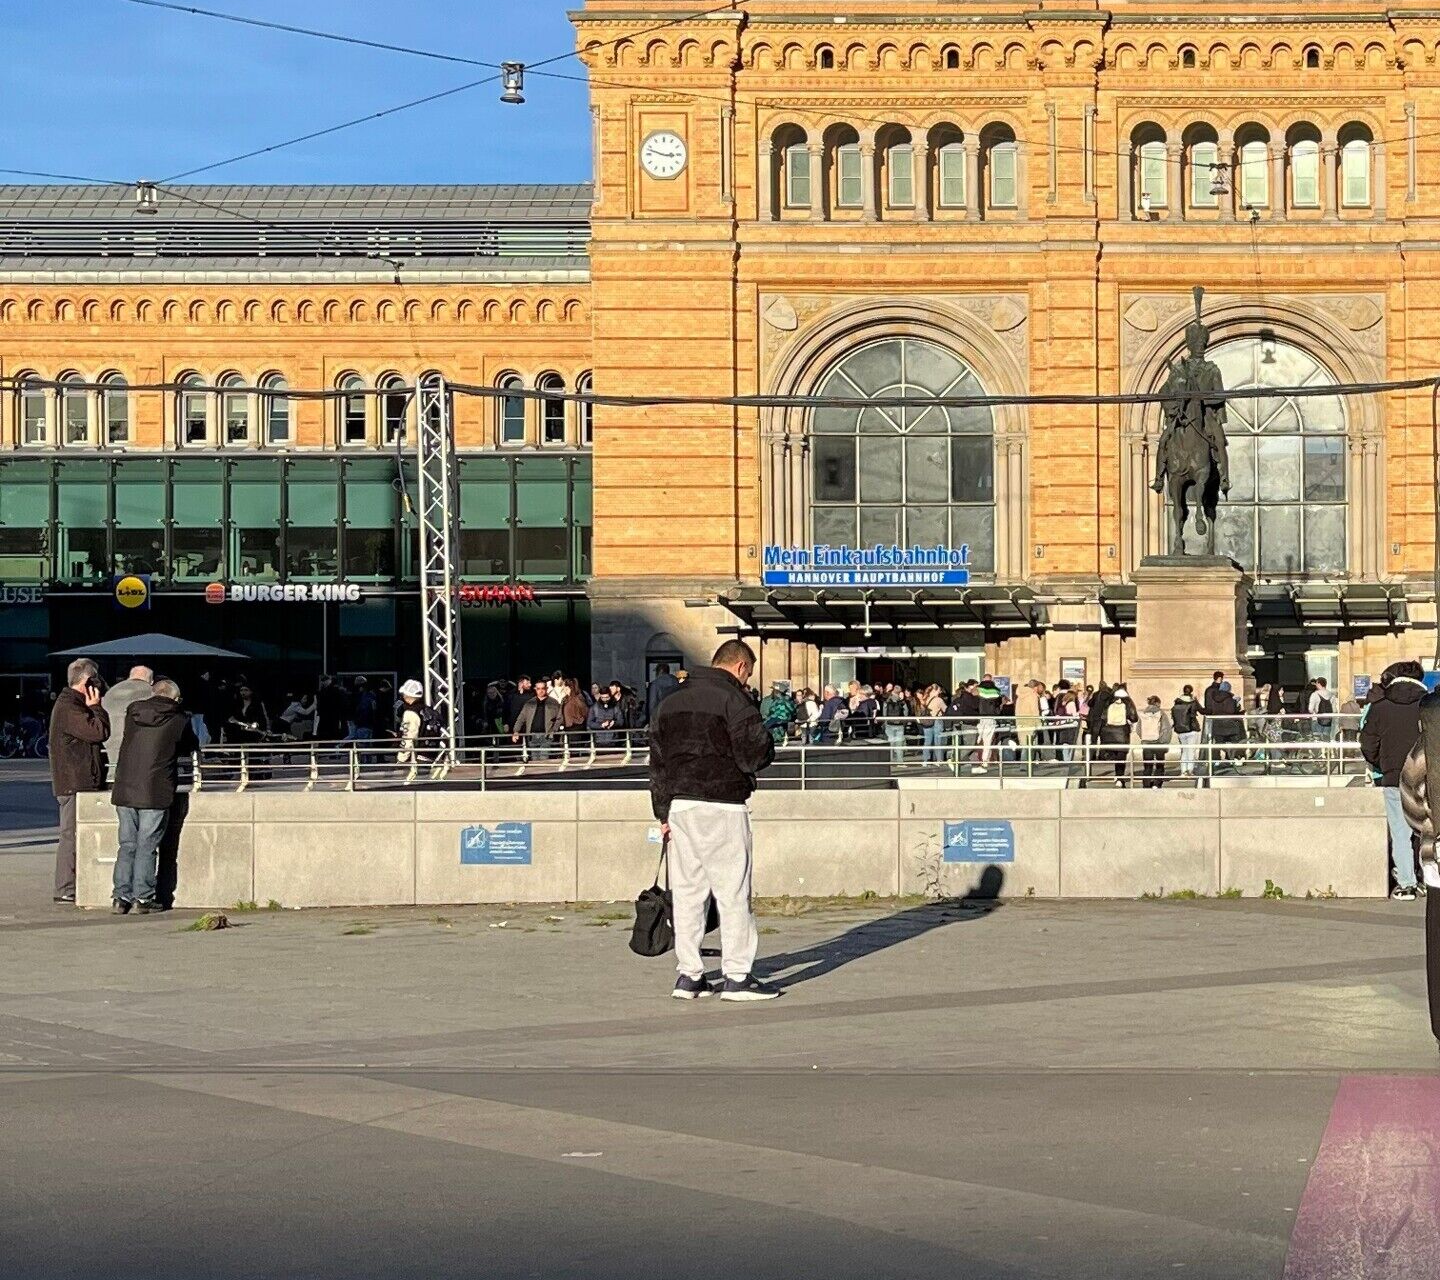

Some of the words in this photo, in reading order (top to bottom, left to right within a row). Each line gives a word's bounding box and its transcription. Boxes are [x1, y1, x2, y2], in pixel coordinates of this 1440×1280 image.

[764, 545, 808, 565] Mein
[813, 544, 969, 566] Einkaufsbahnhof
[788, 572, 850, 583] HANNOVER
[854, 572, 945, 583] HAUPTBAHNHOF
[230, 584, 308, 602] BURGER
[311, 584, 360, 601] KING
